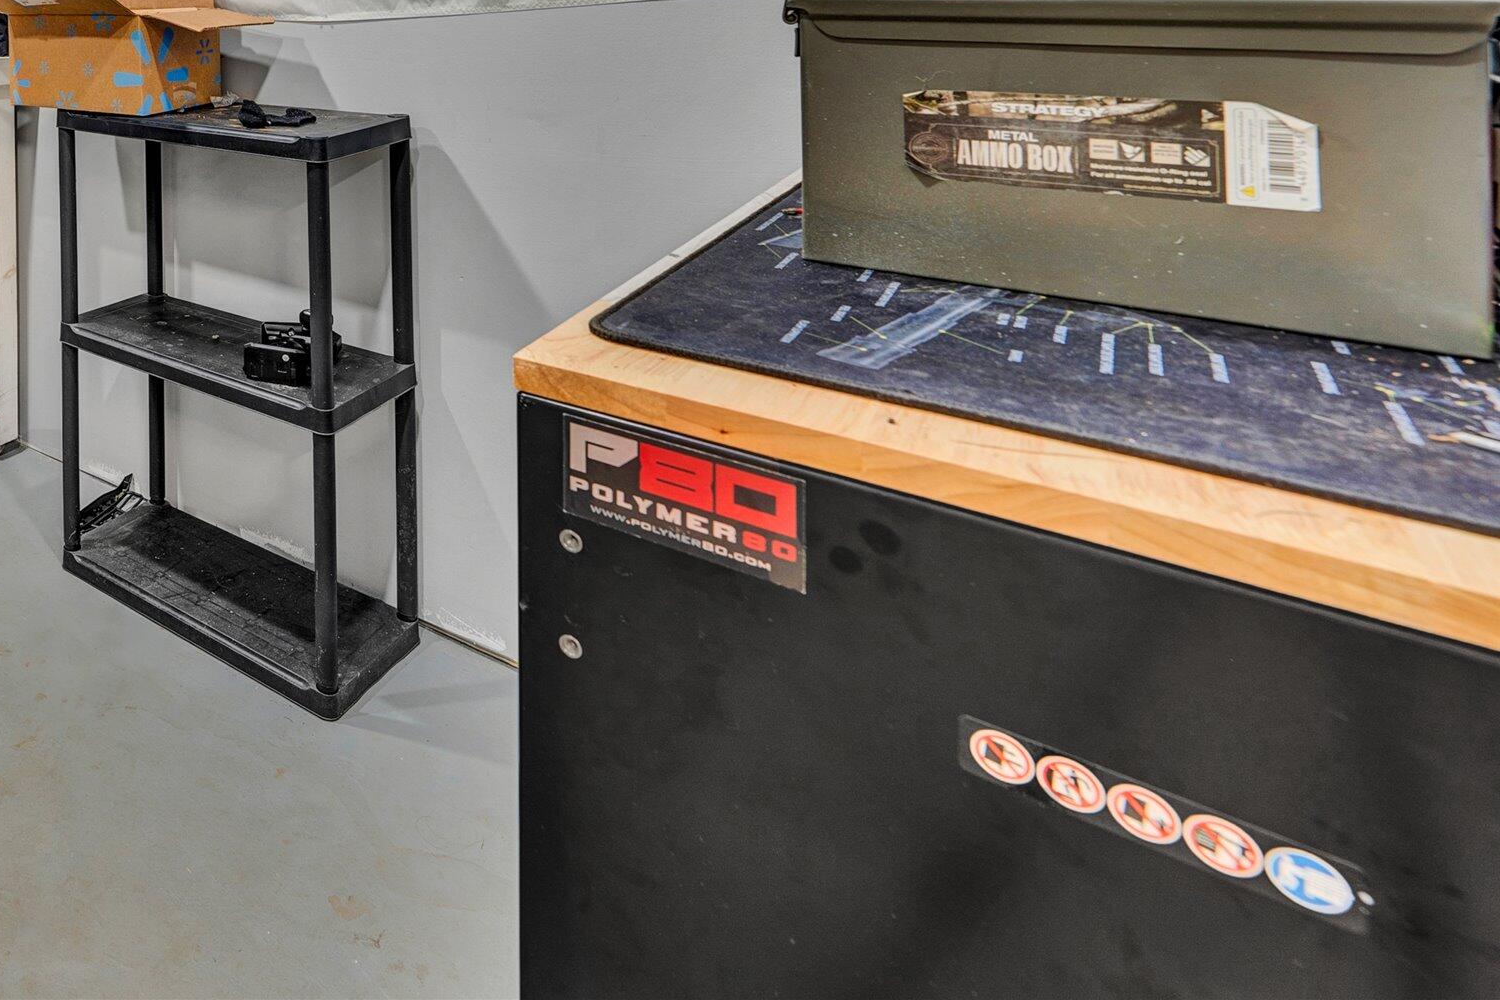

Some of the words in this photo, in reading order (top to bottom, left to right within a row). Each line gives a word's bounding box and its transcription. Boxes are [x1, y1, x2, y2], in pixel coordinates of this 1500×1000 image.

[990, 102, 1105, 119] STRATEGY
[988, 130, 1039, 142] METAL
[957, 139, 1023, 169] AMMO
[1026, 143, 1074, 174] BOX
[1115, 173, 1162, 183] ammunition
[1162, 177, 1174, 185] up
[569, 421, 798, 540] P80
